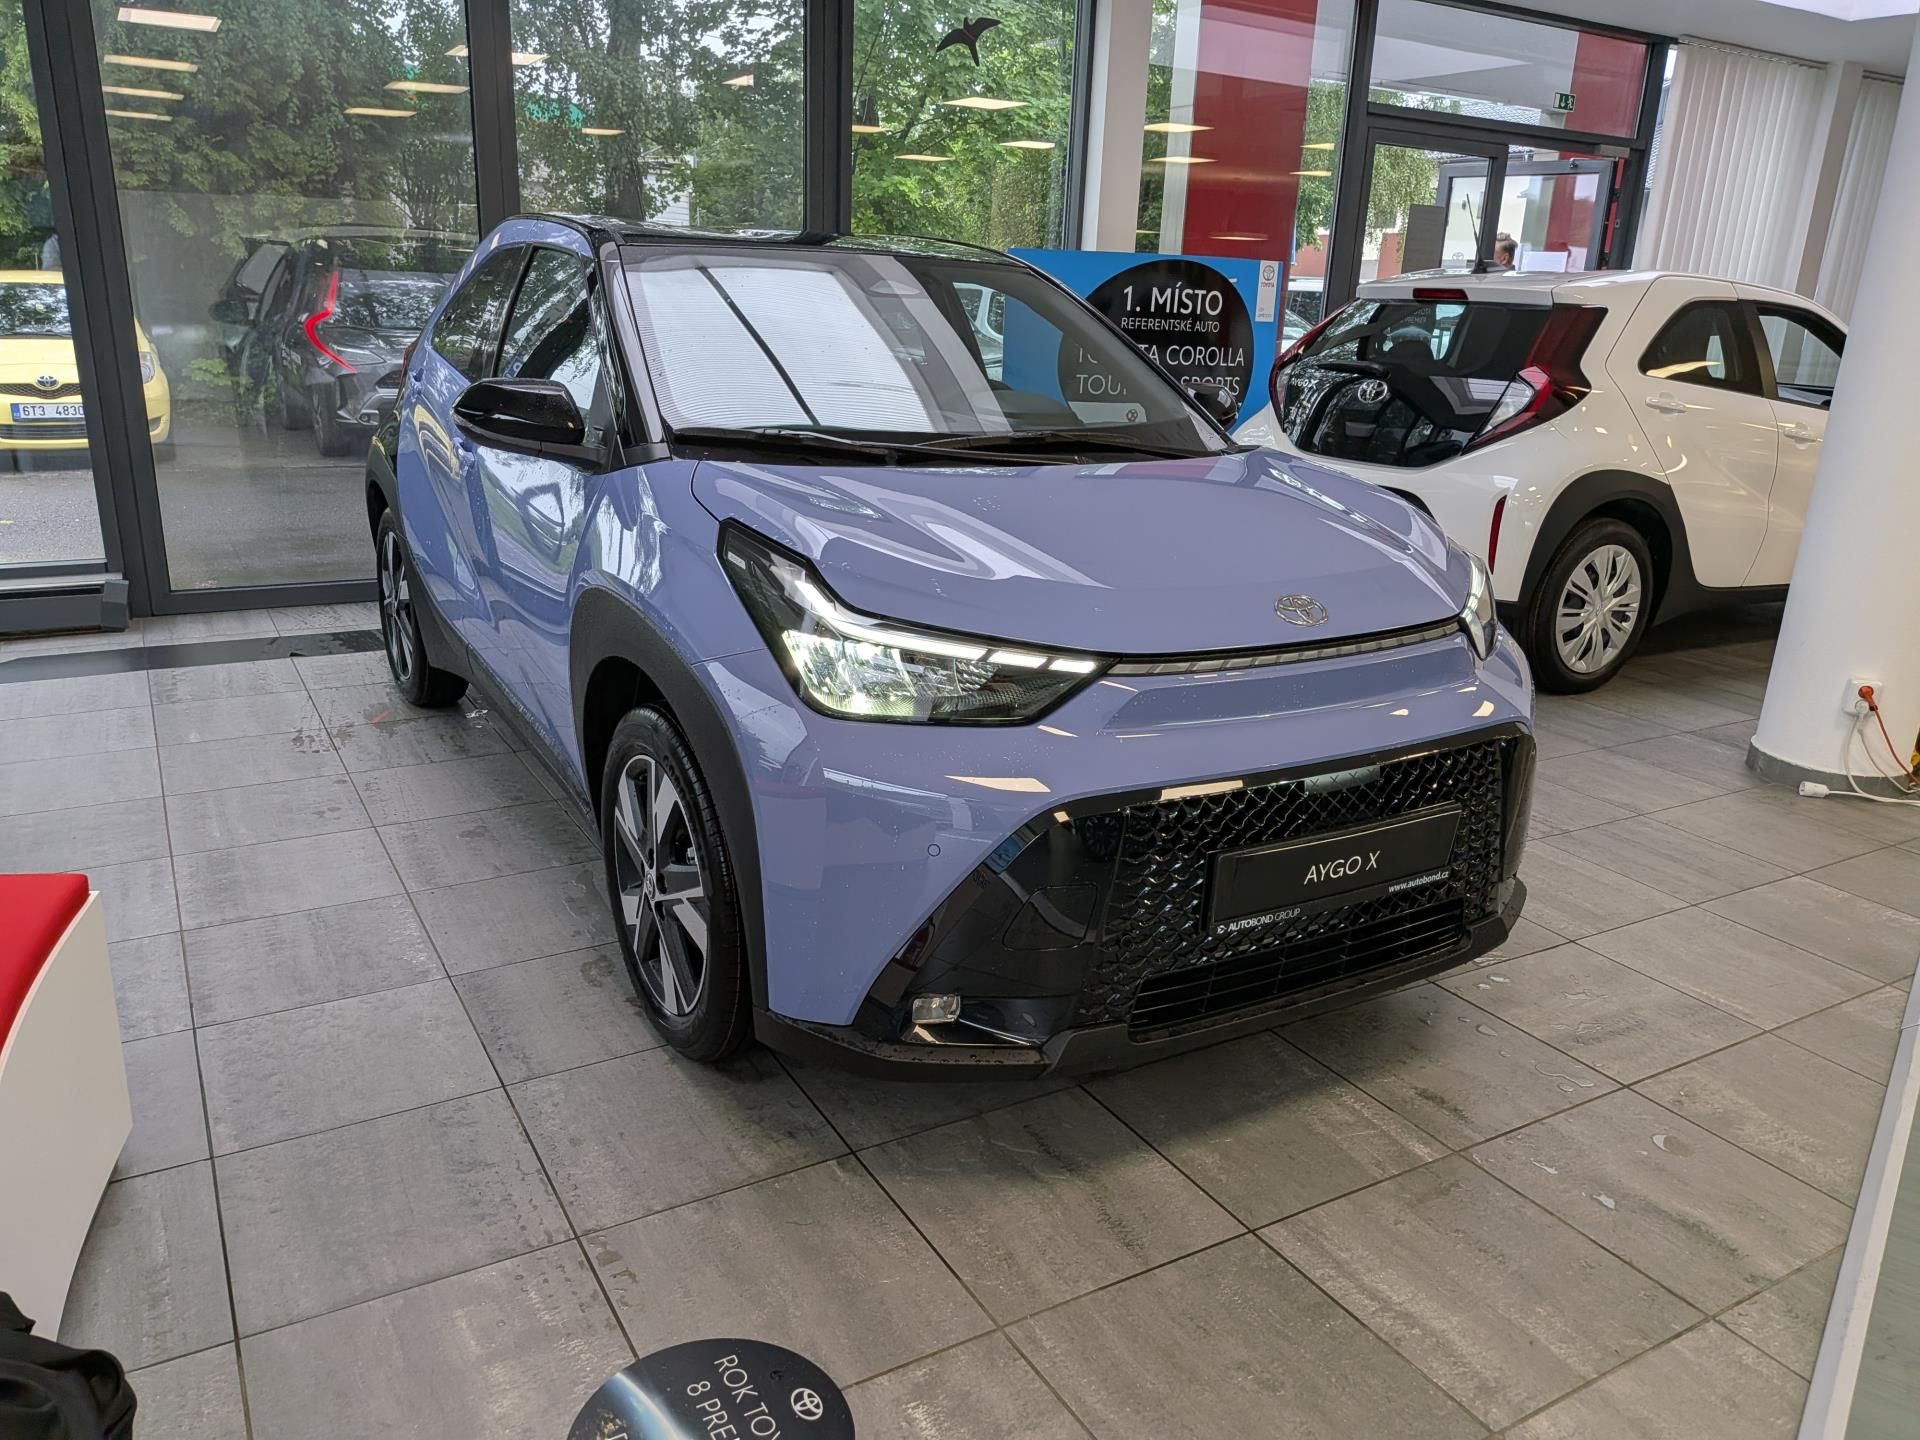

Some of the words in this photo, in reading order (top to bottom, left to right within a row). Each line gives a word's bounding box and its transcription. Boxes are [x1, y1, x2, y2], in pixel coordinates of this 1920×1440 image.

[1123, 285, 1141, 312] 1.
[1150, 281, 1223, 316] MÍSTO
[1121, 317, 1193, 332] REFERENTSKÉ
[1194, 320, 1220, 333] AUTO
[1166, 345, 1245, 367] COROLLA
[22, 405, 46, 416] 6T3
[1303, 855, 1362, 886] AYGO
[1365, 850, 1381, 871] X
[1388, 871, 1449, 893] www.autobond.cz
[1227, 914, 1274, 932] AUTOBOND
[1274, 907, 1301, 921] GROUP
[687, 1380, 711, 1396] 8
[713, 1354, 759, 1404] ROK
[743, 1401, 781, 1440] TO
[695, 1398, 741, 1440] PRE
